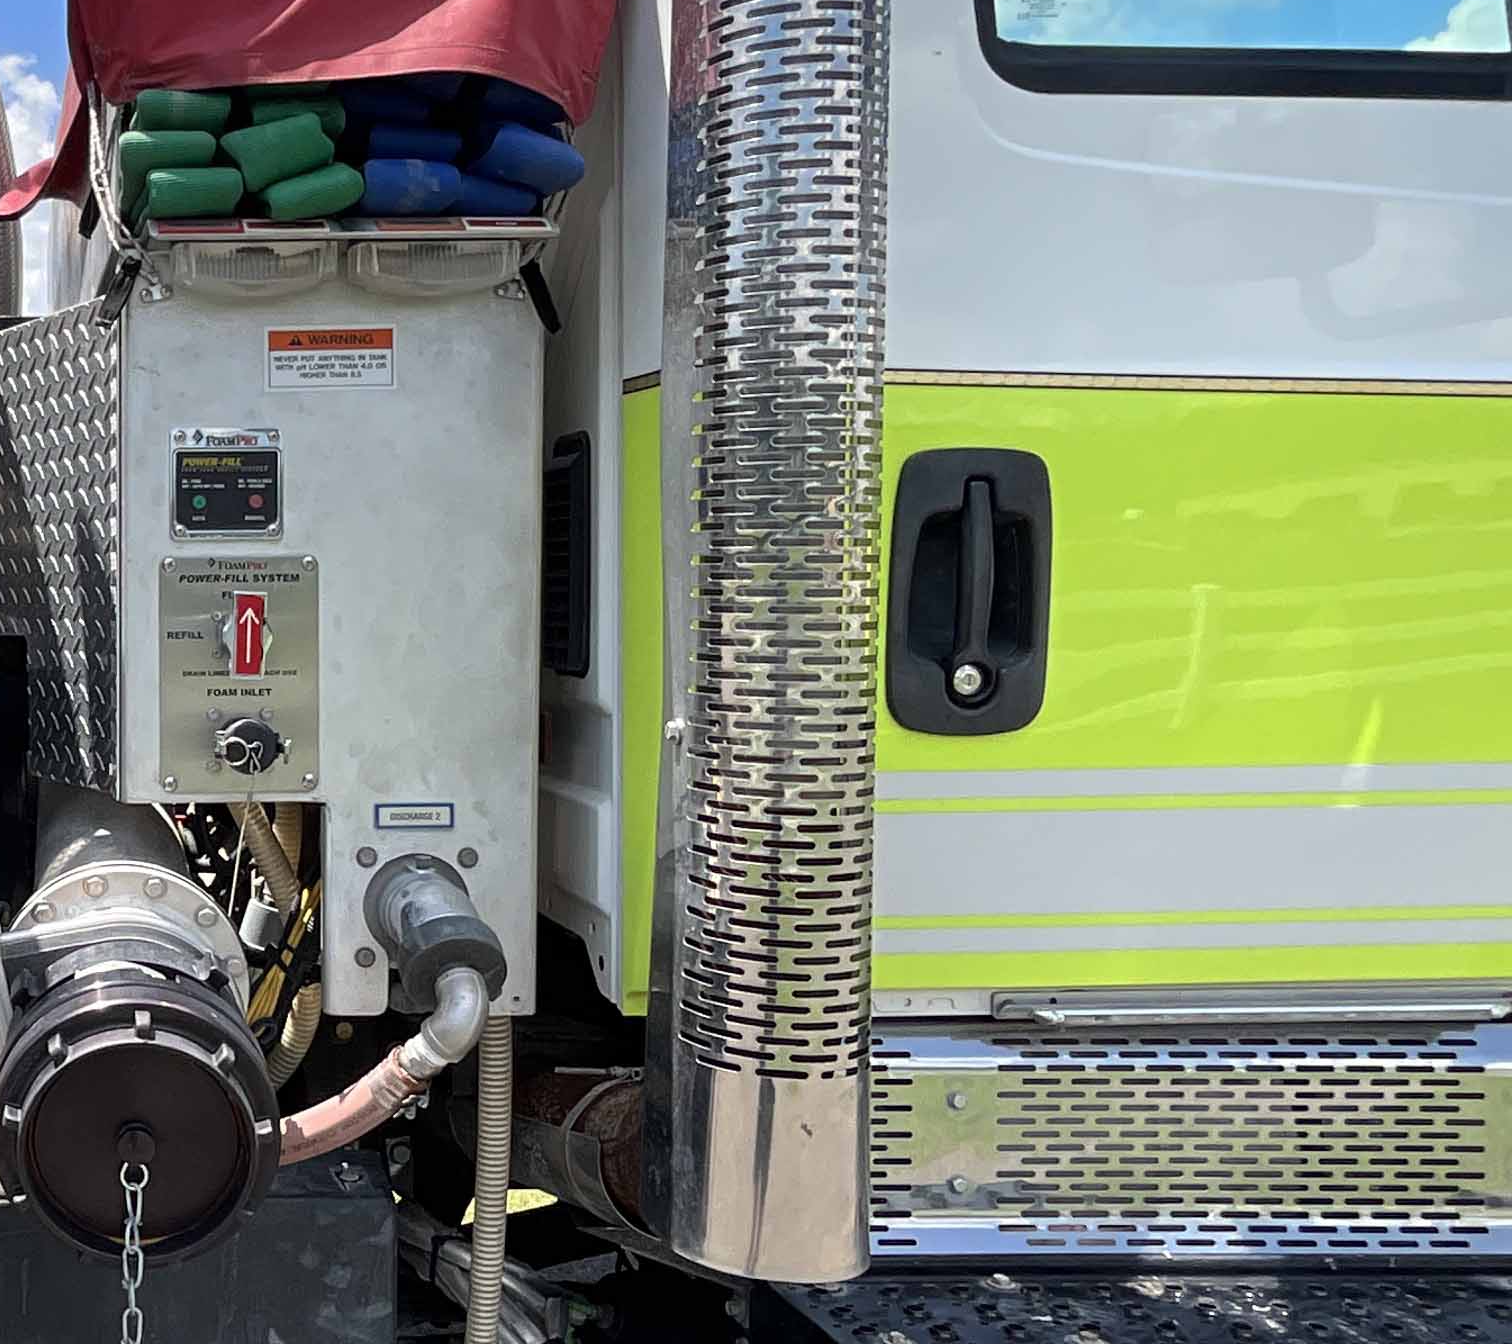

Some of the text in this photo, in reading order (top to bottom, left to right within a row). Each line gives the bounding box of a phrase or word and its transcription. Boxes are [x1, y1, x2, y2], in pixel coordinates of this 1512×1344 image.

[308, 333, 374, 345] WARNING
[178, 573, 300, 583] POWER-FILL SYSTEM
[166, 631, 204, 639] REFILL
[206, 688, 272, 696] FOAM INLET
